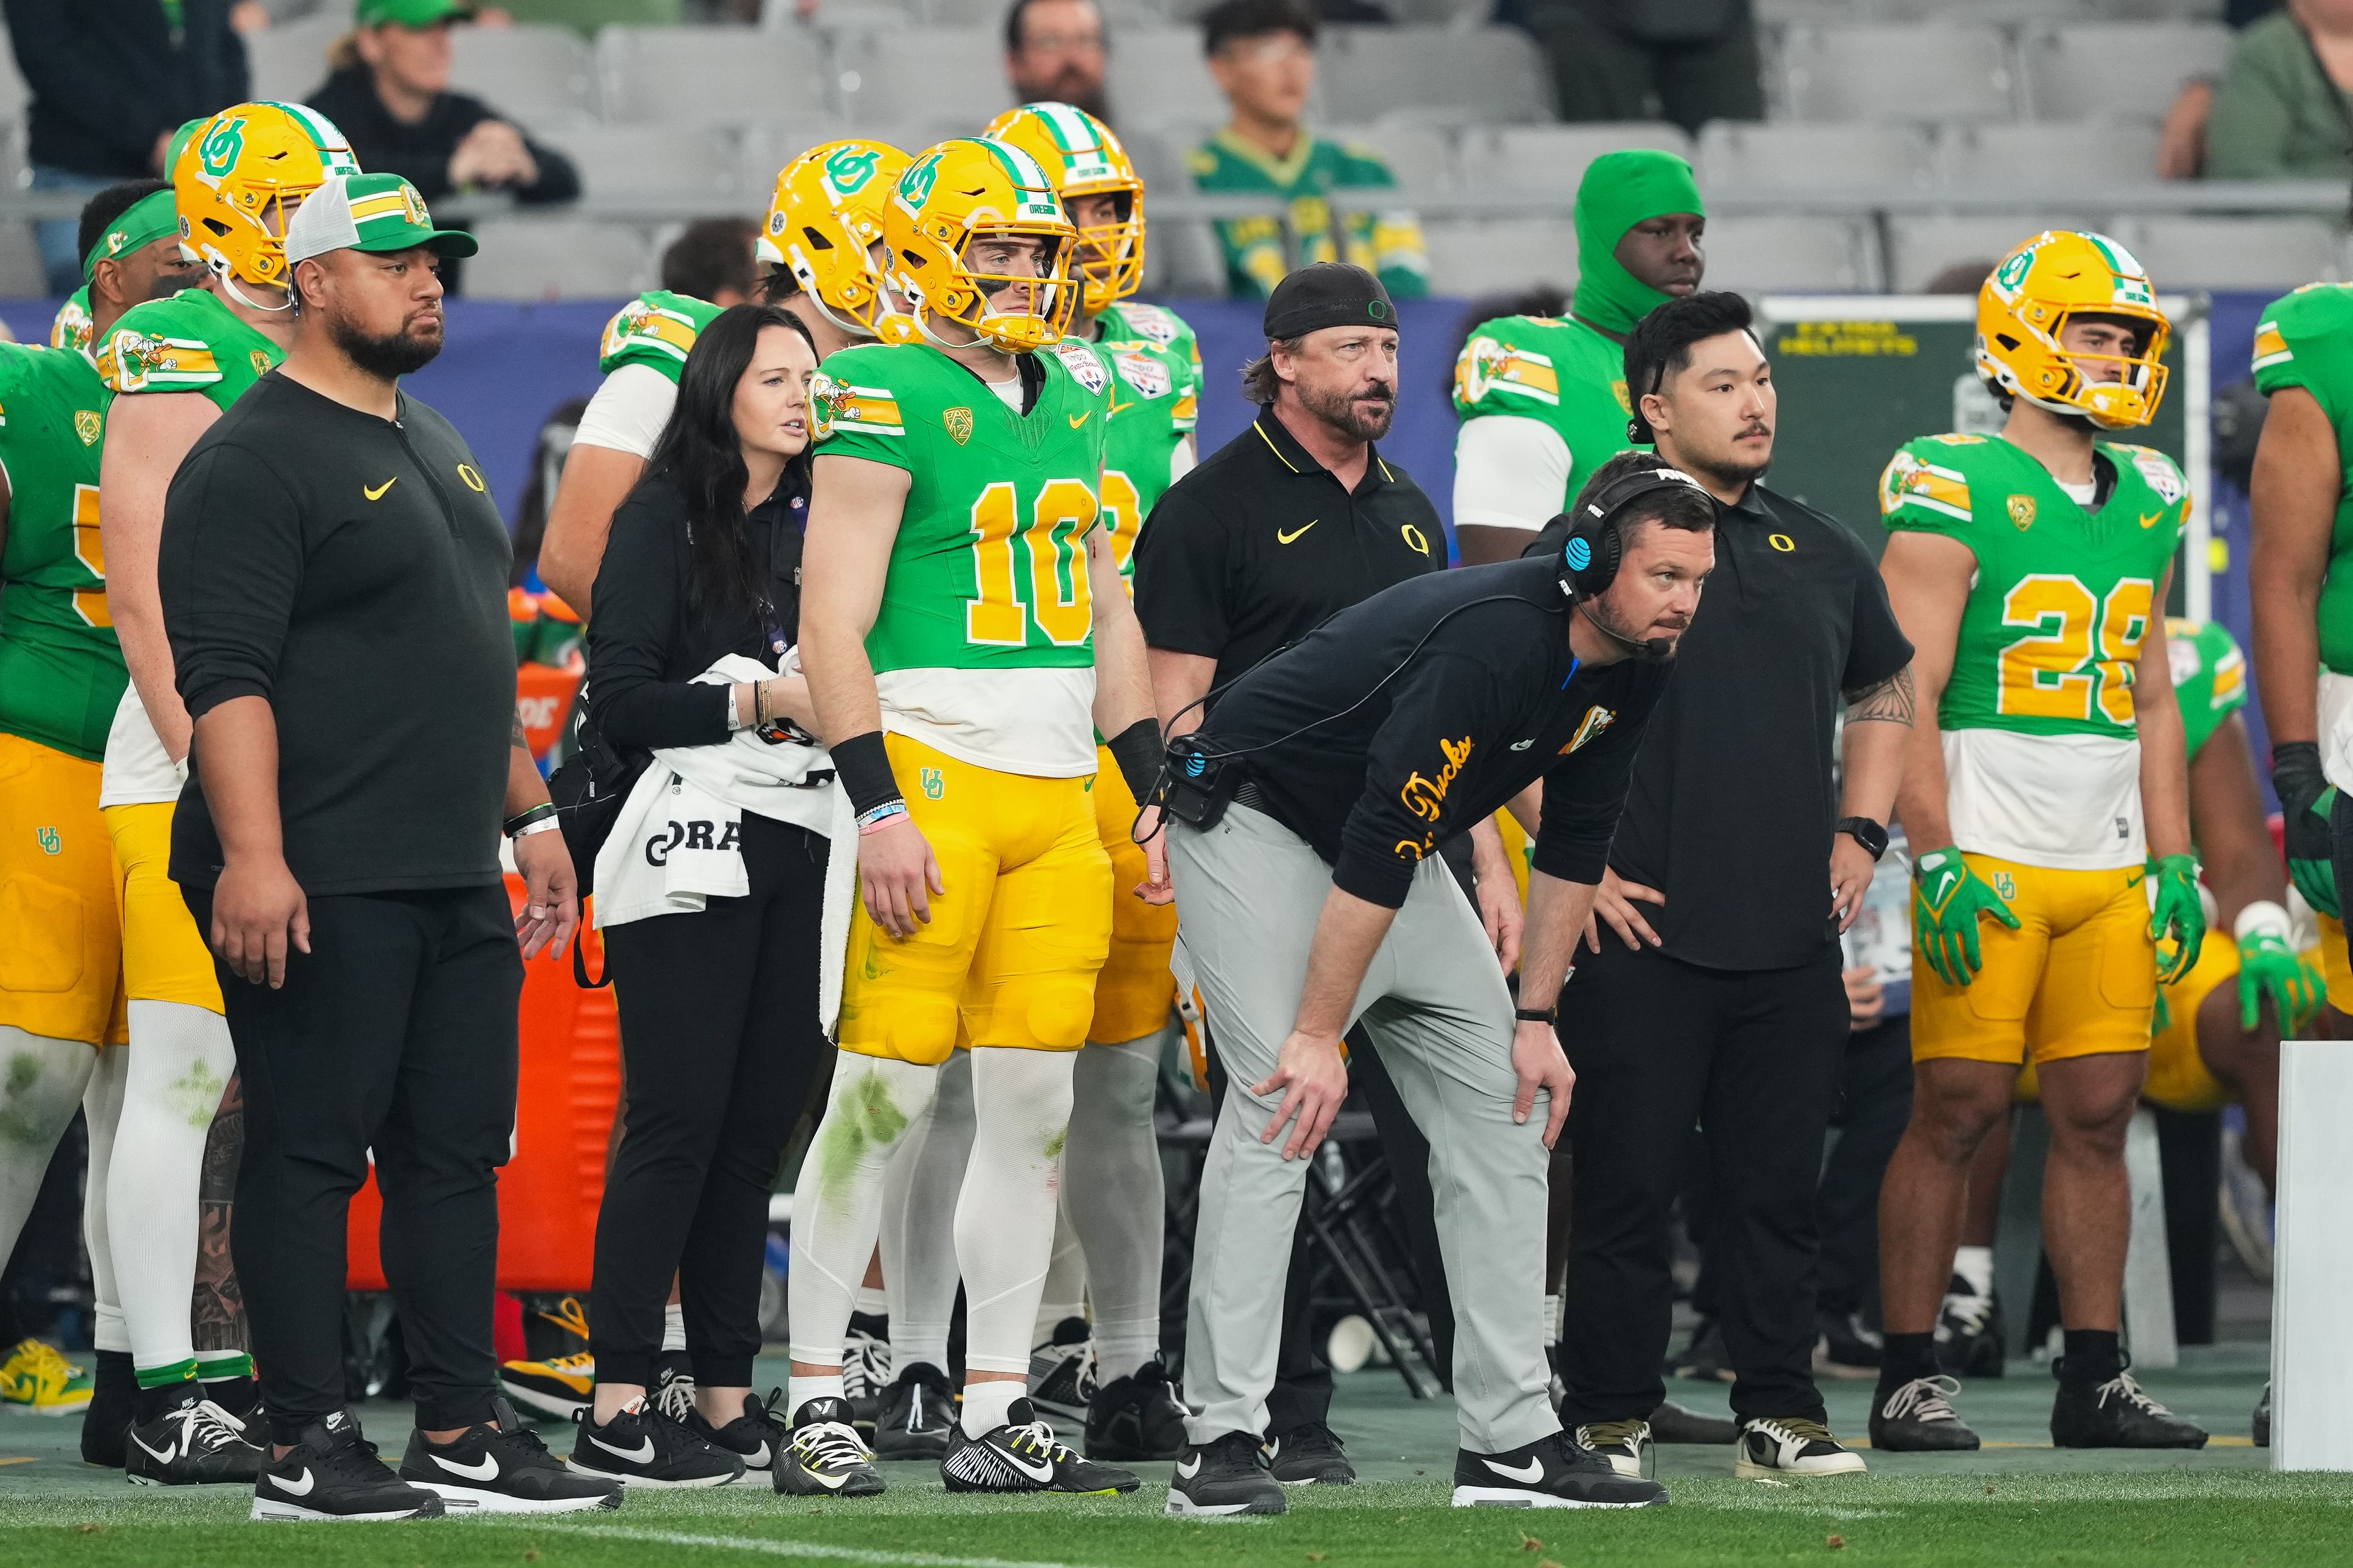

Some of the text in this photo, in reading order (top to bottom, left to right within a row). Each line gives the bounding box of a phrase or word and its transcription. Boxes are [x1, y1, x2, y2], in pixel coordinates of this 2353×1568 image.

[967, 478, 1099, 646] 10
[1997, 573, 2153, 727] 28
[1401, 735, 1471, 822] Ducks
[182, 1397, 194, 1409] NIKE
